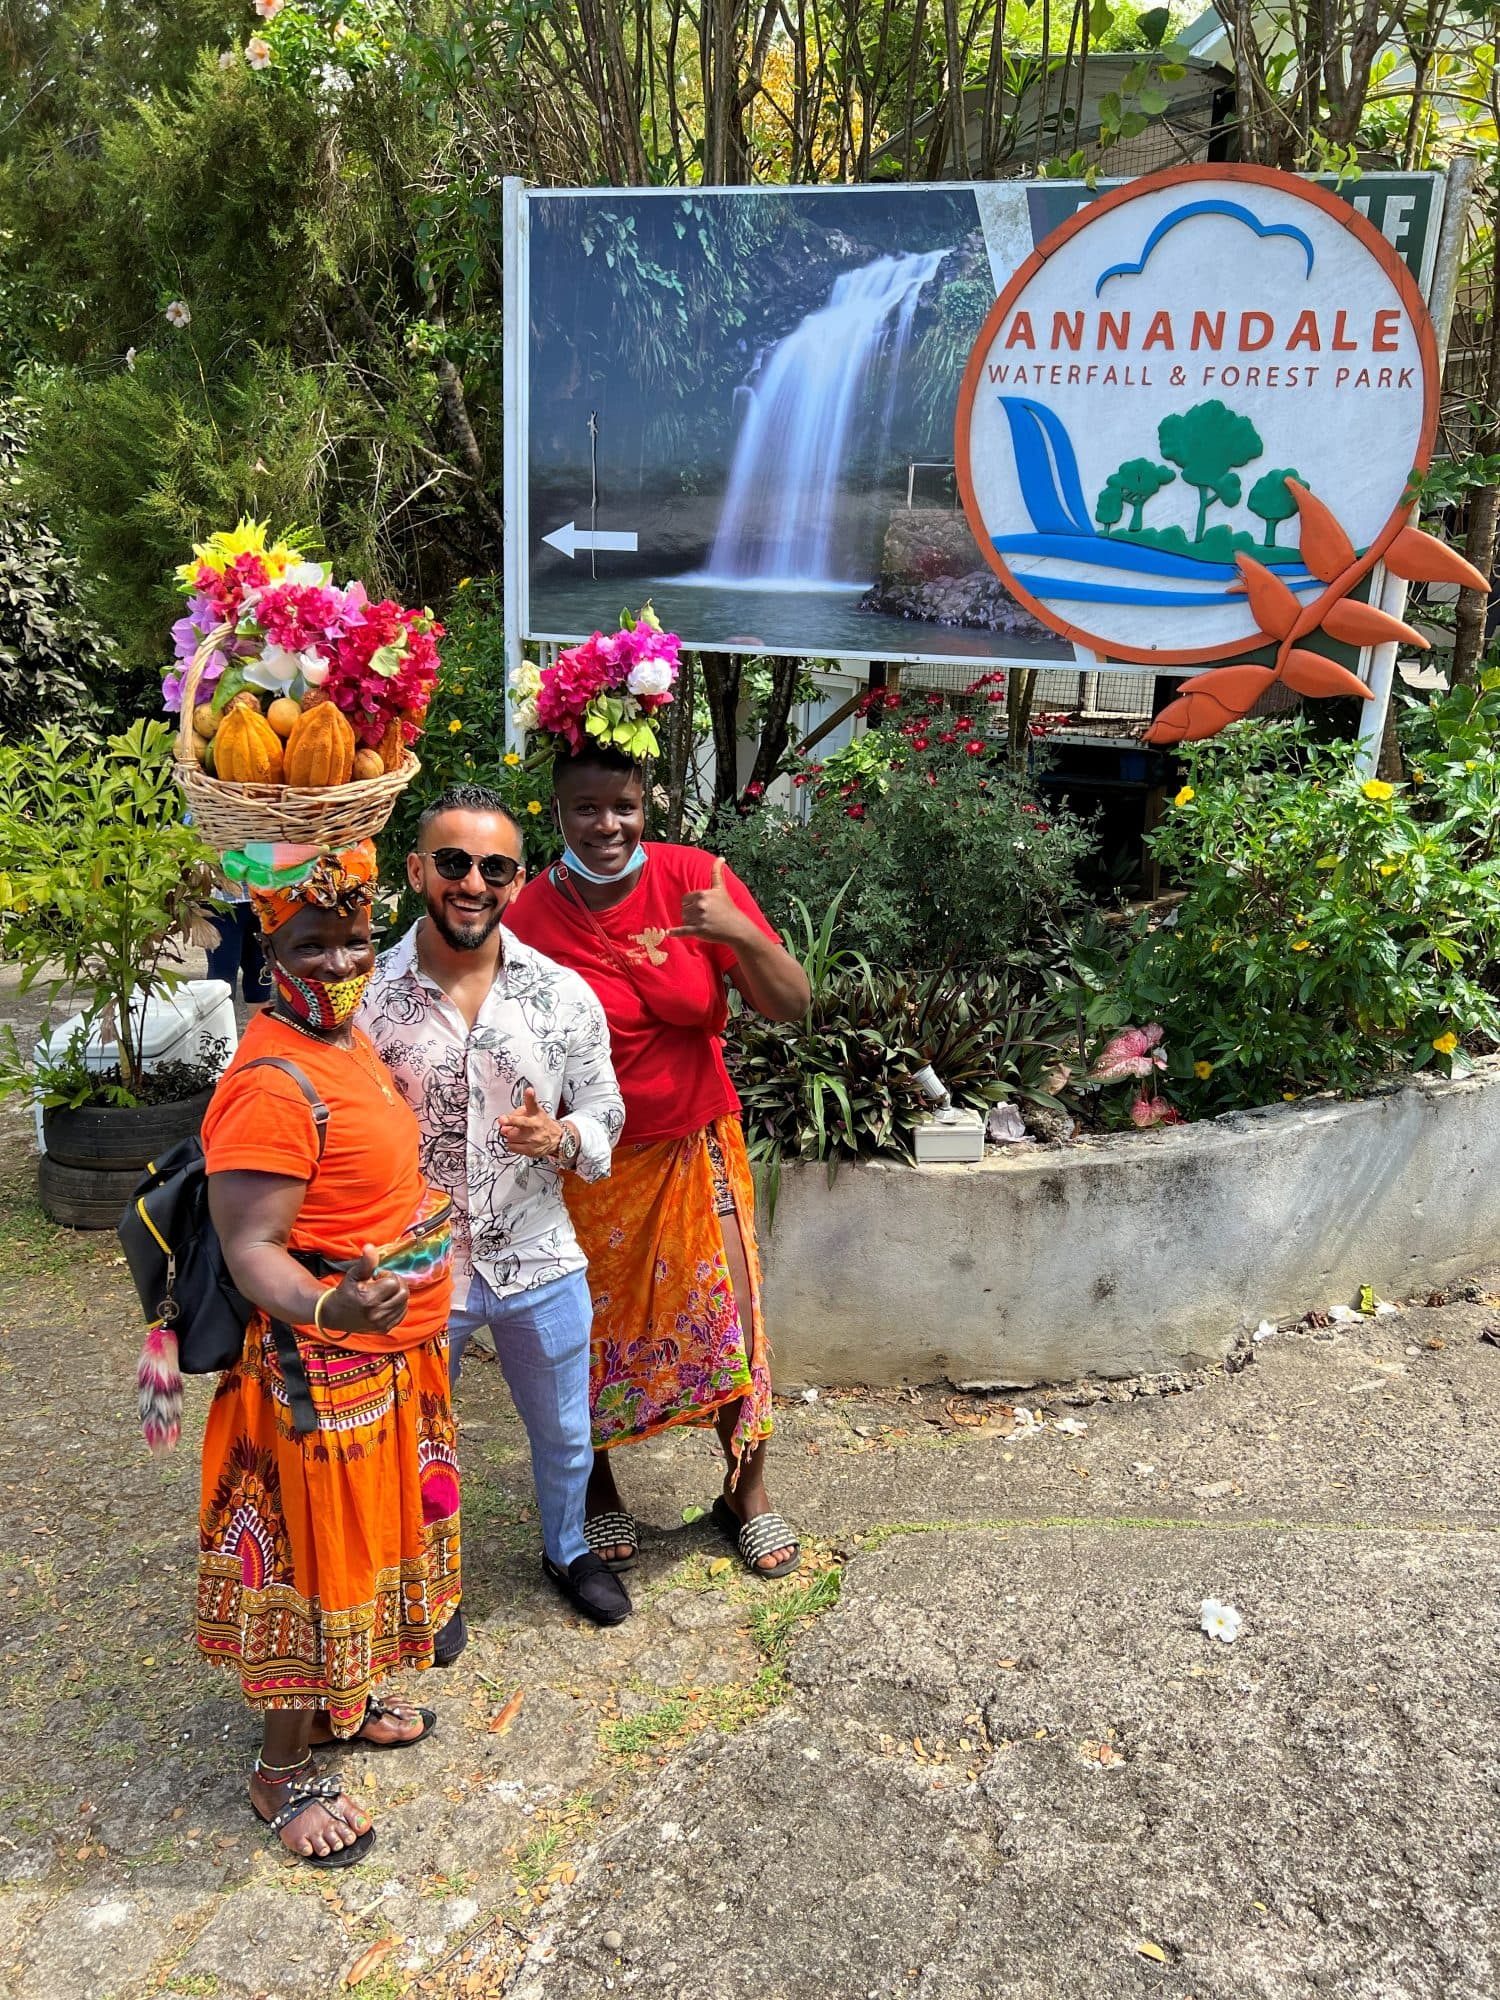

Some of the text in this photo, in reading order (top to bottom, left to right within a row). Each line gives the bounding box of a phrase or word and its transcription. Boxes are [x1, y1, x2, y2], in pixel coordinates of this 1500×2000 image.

[1006, 310, 1401, 352] ANNANDALE
[987, 364, 1415, 388] WATERFALL & FOREST PARK
